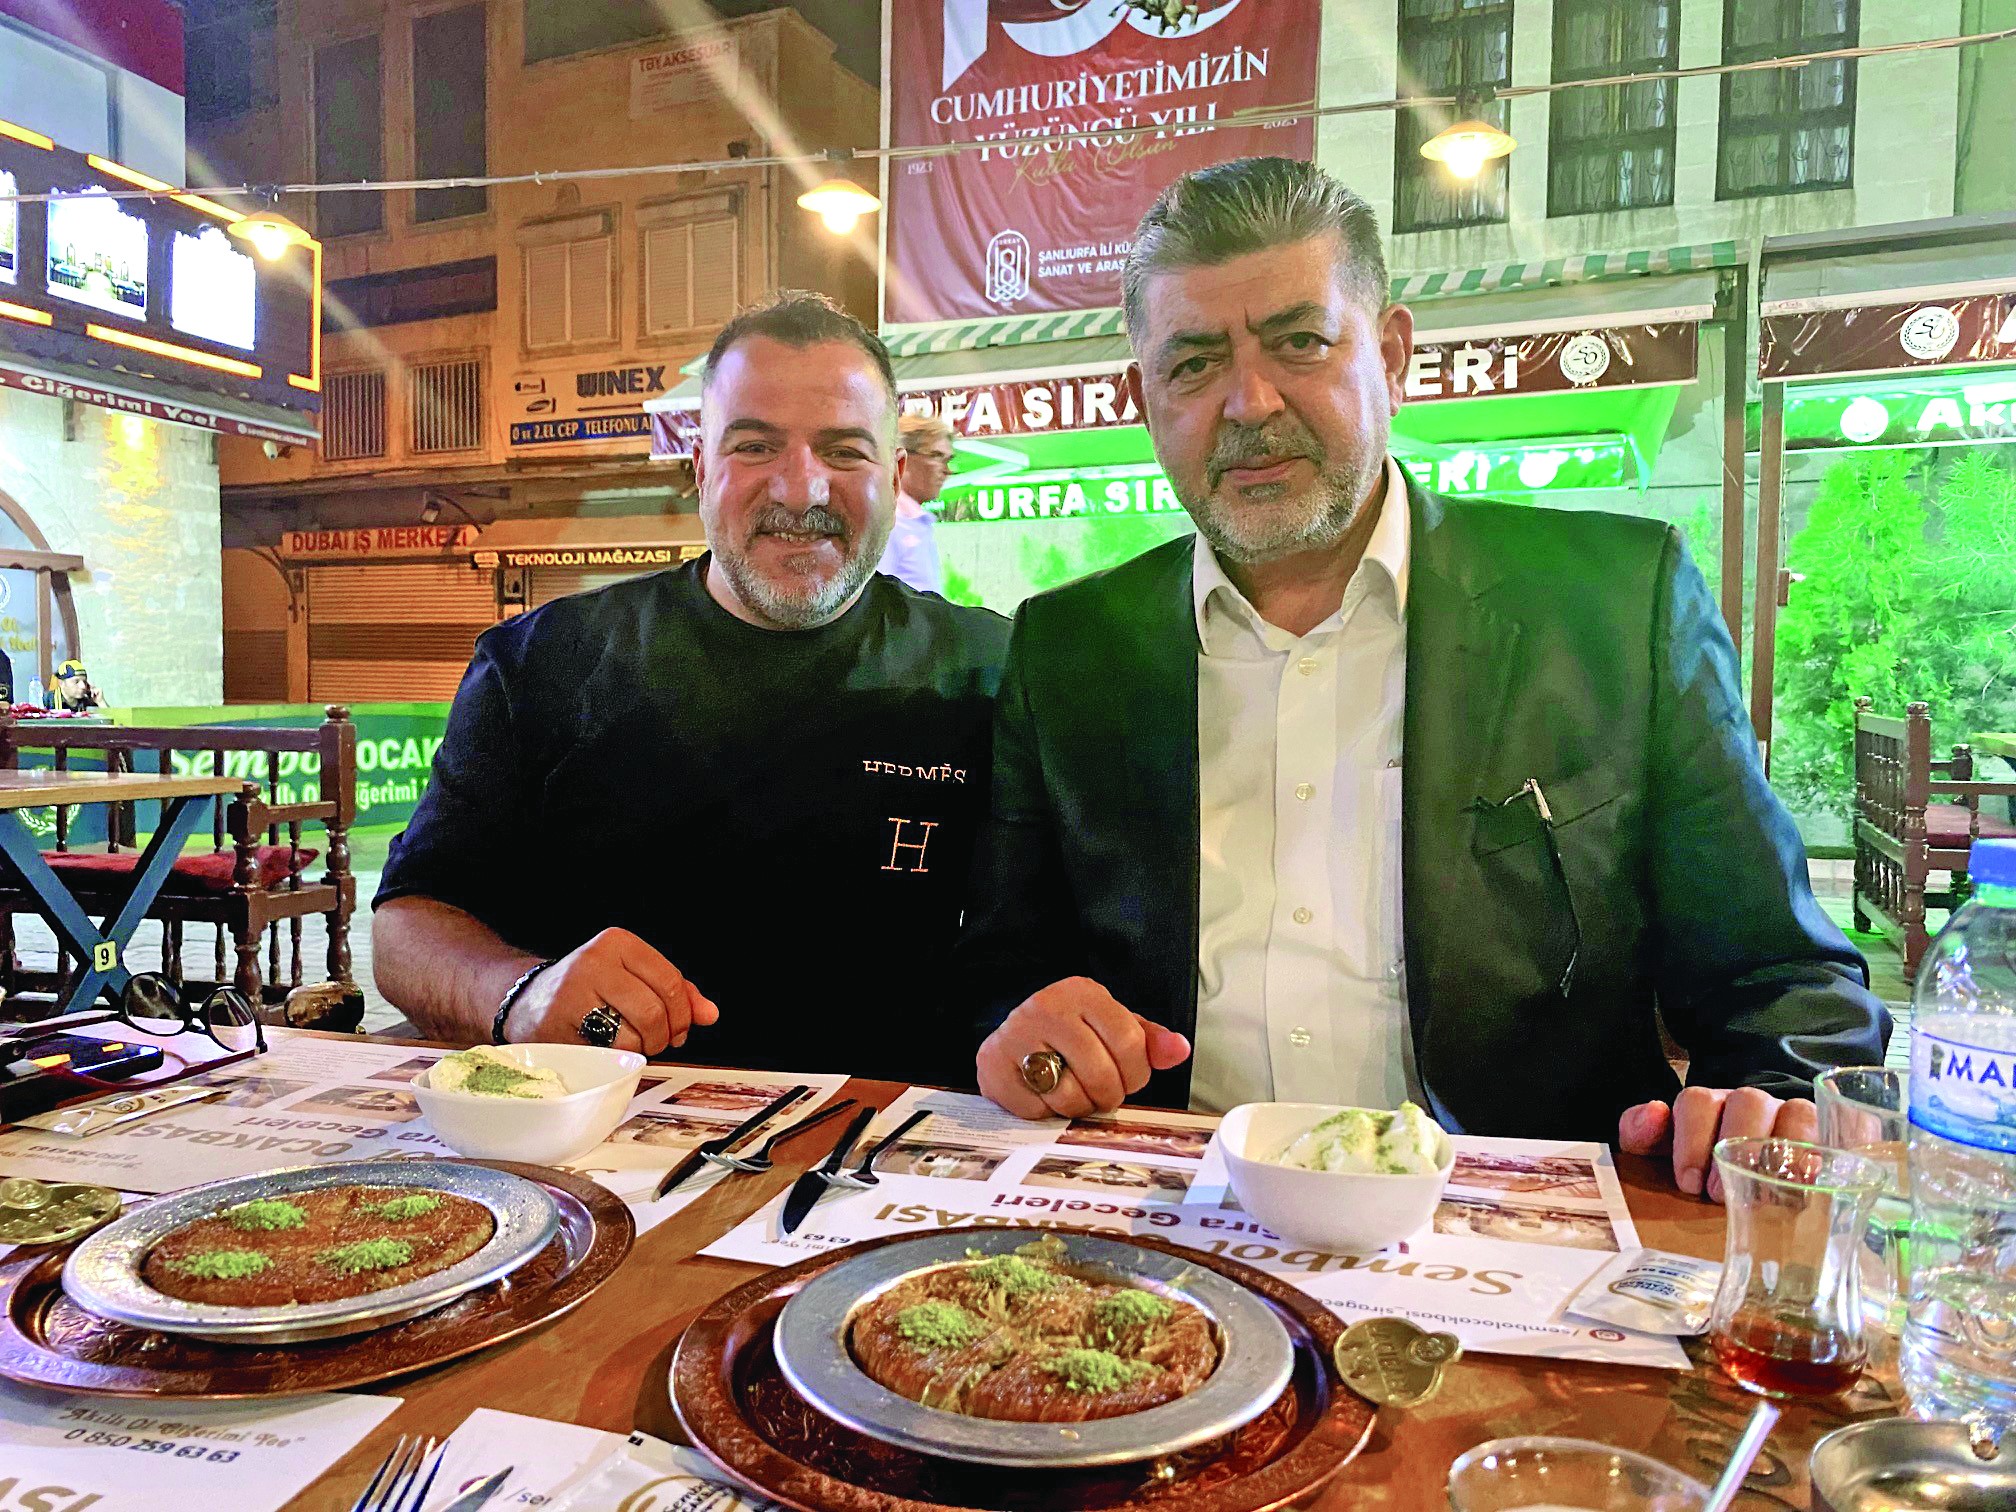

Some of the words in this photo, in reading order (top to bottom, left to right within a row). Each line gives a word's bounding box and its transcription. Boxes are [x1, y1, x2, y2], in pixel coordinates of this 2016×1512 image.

[930, 45, 1269, 125] CUMHURİYETİMİZİN
[974, 107, 1138, 162] YÜZÜNCÜ
[1149, 101, 1218, 141] YILI
[1038, 245, 1098, 264] ŞANLIURFA
[1038, 264, 1074, 278] SANAT
[1077, 263, 1092, 275] VE
[576, 365, 666, 399] WINEX
[557, 421, 580, 437] CEP
[585, 416, 639, 436] TELEFONU
[977, 482, 1088, 521] URFA
[588, 547, 671, 565] MAĞAZASI
[880, 816, 940, 873] H
[101, 947, 109, 966] 9
[1946, 1049, 2016, 1089] MA
[113, 1123, 354, 1160] OCAKBAŞI
[233, 1116, 389, 1140] Geceleri
[993, 1193, 1182, 1227] Geceleri
[64, 1428, 79, 1440] 0
[84, 1430, 132, 1448] 850
[127, 1438, 176, 1455] 259
[174, 1445, 208, 1460] 63
[206, 1449, 241, 1464] 63
